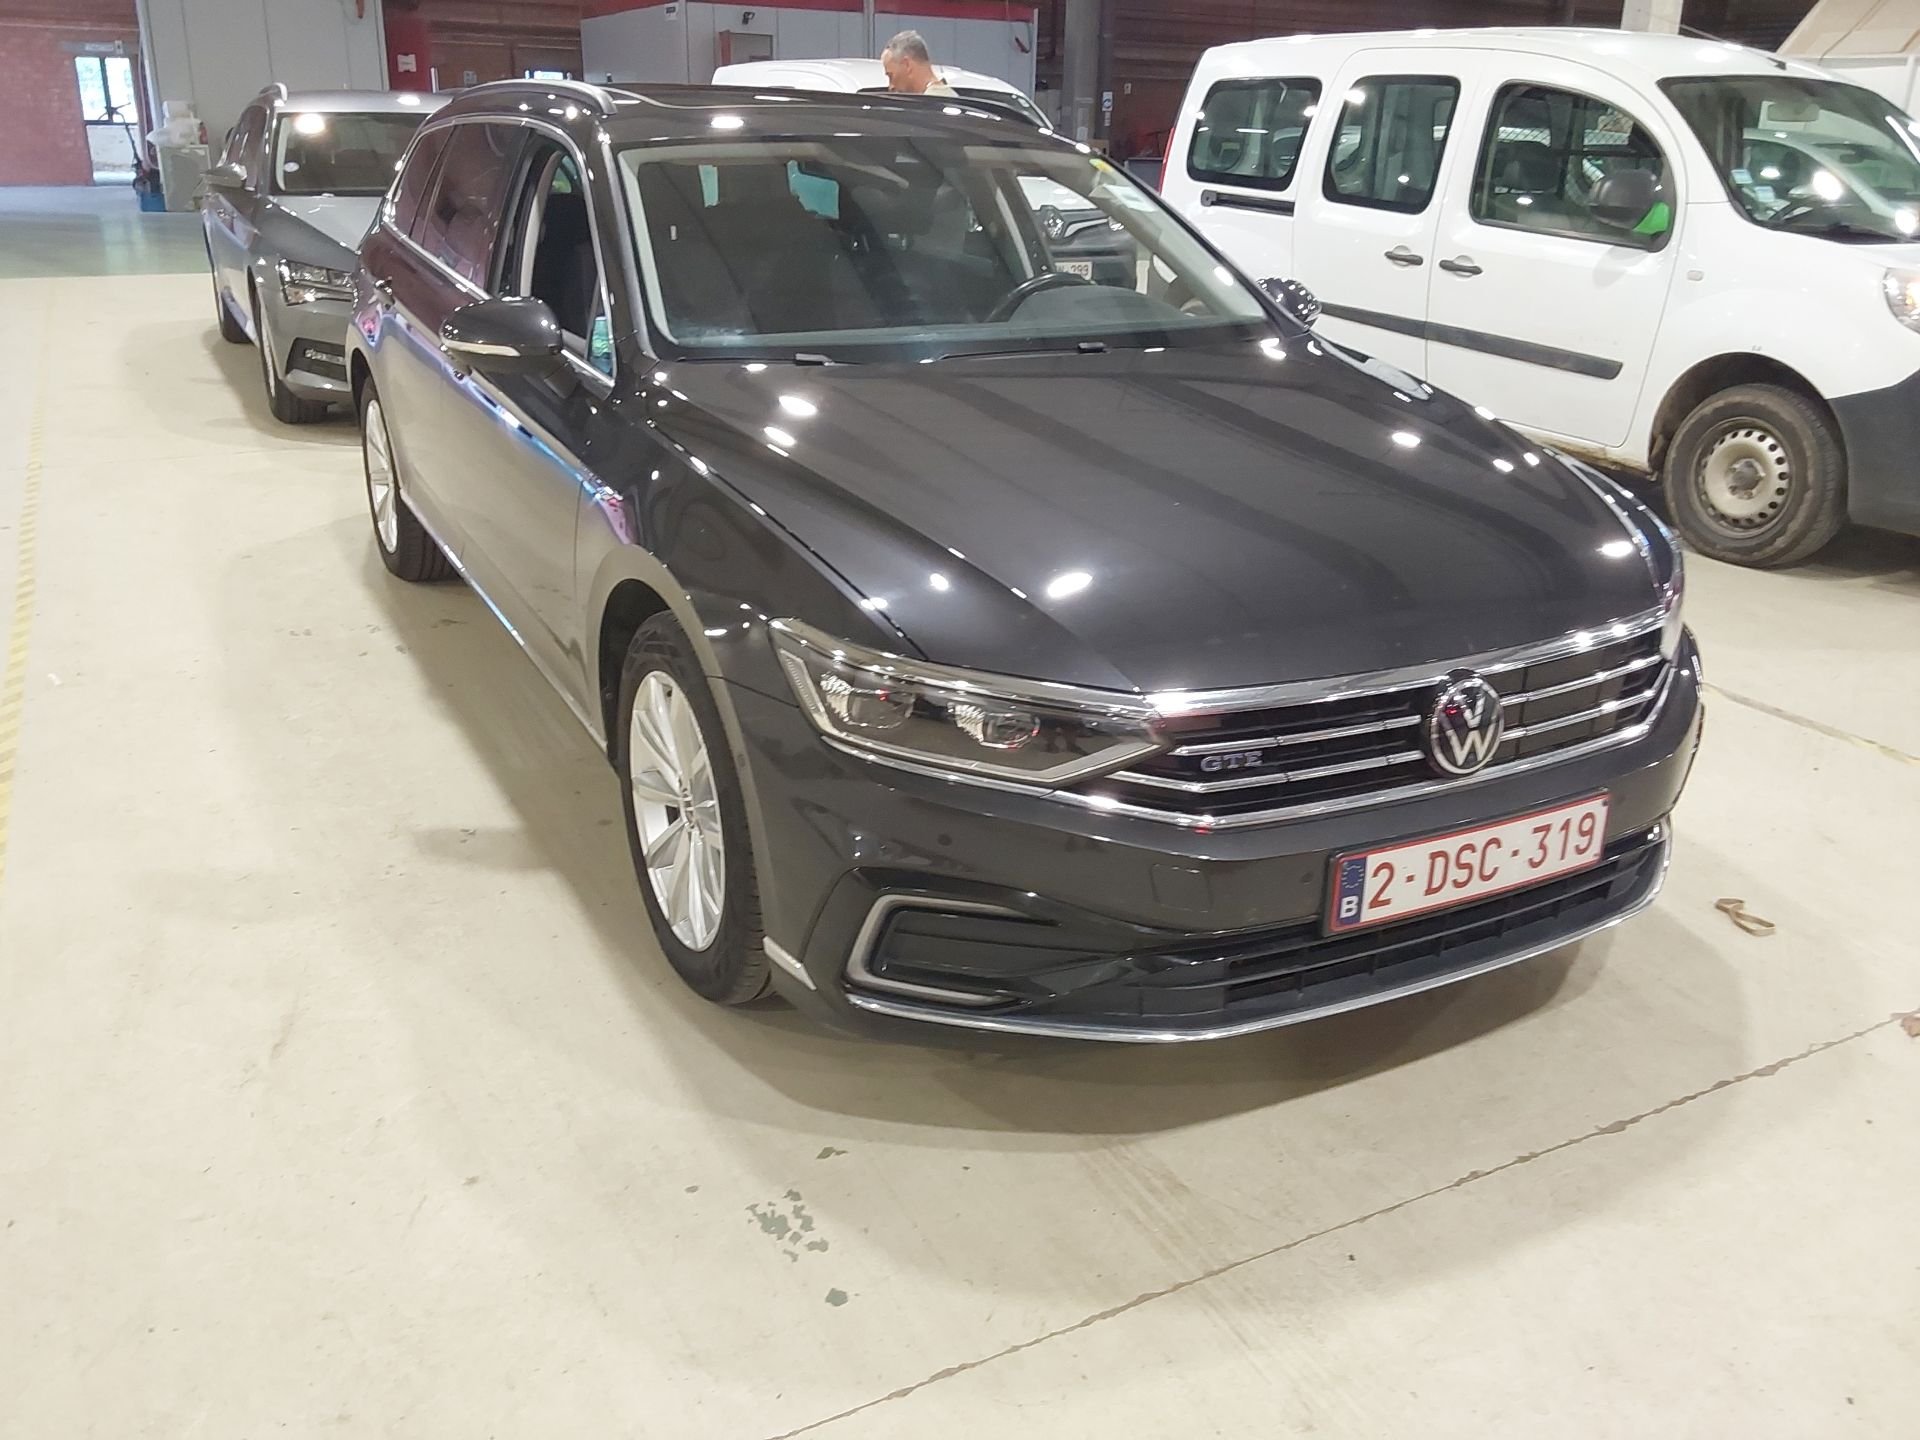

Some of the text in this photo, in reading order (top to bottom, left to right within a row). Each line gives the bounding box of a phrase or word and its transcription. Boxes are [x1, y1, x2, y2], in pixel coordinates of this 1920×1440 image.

[1200, 750, 1263, 772] GTE
[1339, 811, 1597, 919] B 2-DSC-319
